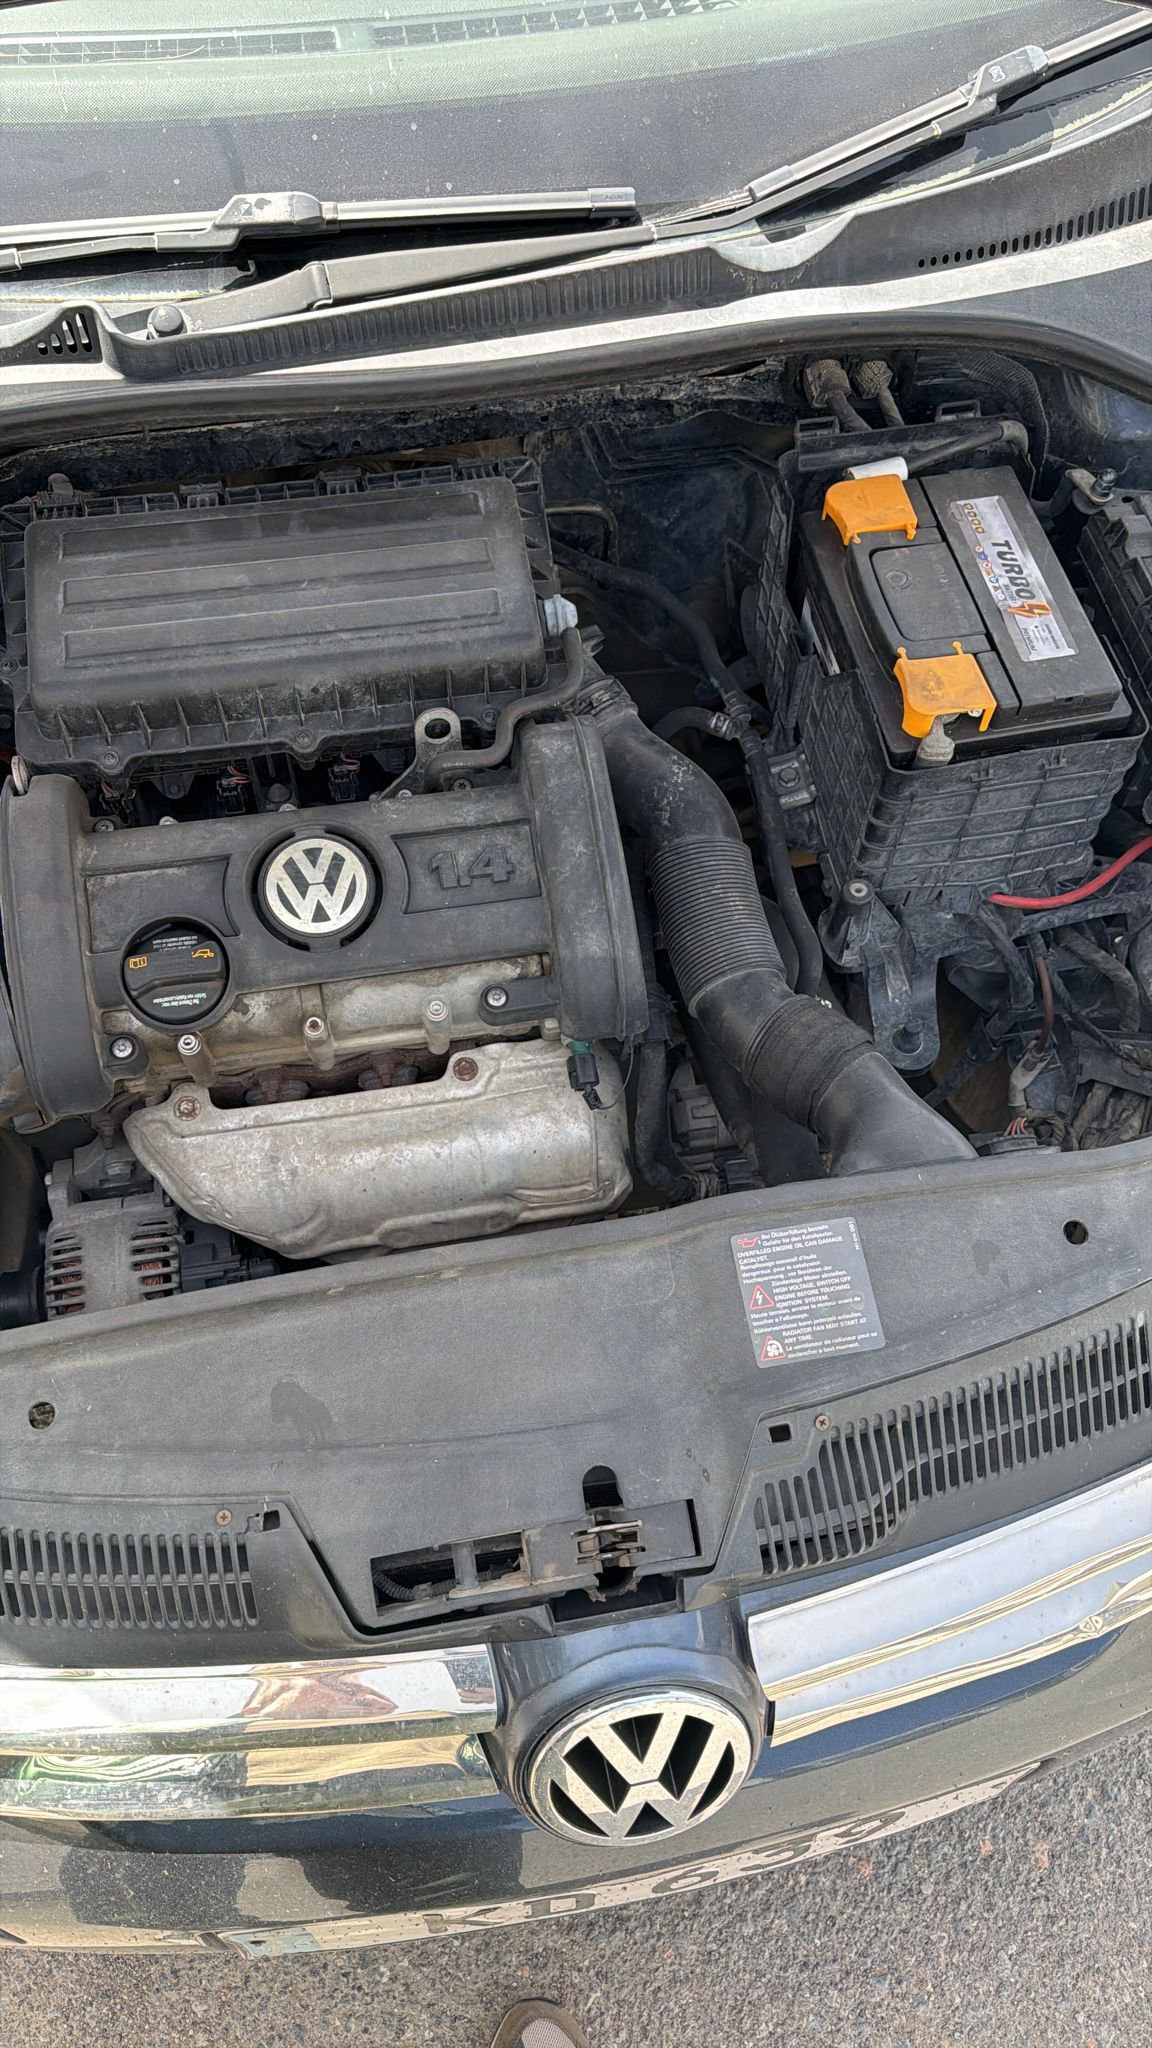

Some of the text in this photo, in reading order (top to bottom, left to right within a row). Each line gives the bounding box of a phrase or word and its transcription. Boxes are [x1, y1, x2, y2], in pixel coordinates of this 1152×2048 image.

[991, 539, 1036, 601] TURBO
[1022, 627, 1037, 652] PREMIUM
[807, 1224, 828, 1232] besteht
[736, 1246, 771, 1257] OVERFILLED
[772, 1243, 793, 1252] ENGINE
[817, 1235, 843, 1244] DAMAGE
[762, 1238, 781, 1246] Gefahr
[739, 1260, 775, 1271] Remplissage
[775, 1255, 798, 1264] excessif
[741, 1268, 770, 1277] dangereux
[815, 1277, 839, 1286] SWITCH
[774, 1283, 850, 1300] ENGINE BEFORE TOUCHING
[775, 1298, 802, 1307] IGNITION
[816, 1299, 836, 1307] moteur
[751, 1318, 773, 1326] toucher
[781, 1326, 812, 1336] RADIATOR
[839, 1318, 859, 1327] START
[793, 1340, 822, 1349] ventilateur
[831, 1334, 856, 1343] radiateur
[856, 1331, 870, 1340] peut
[422, 1810, 907, 1934] KD 639
